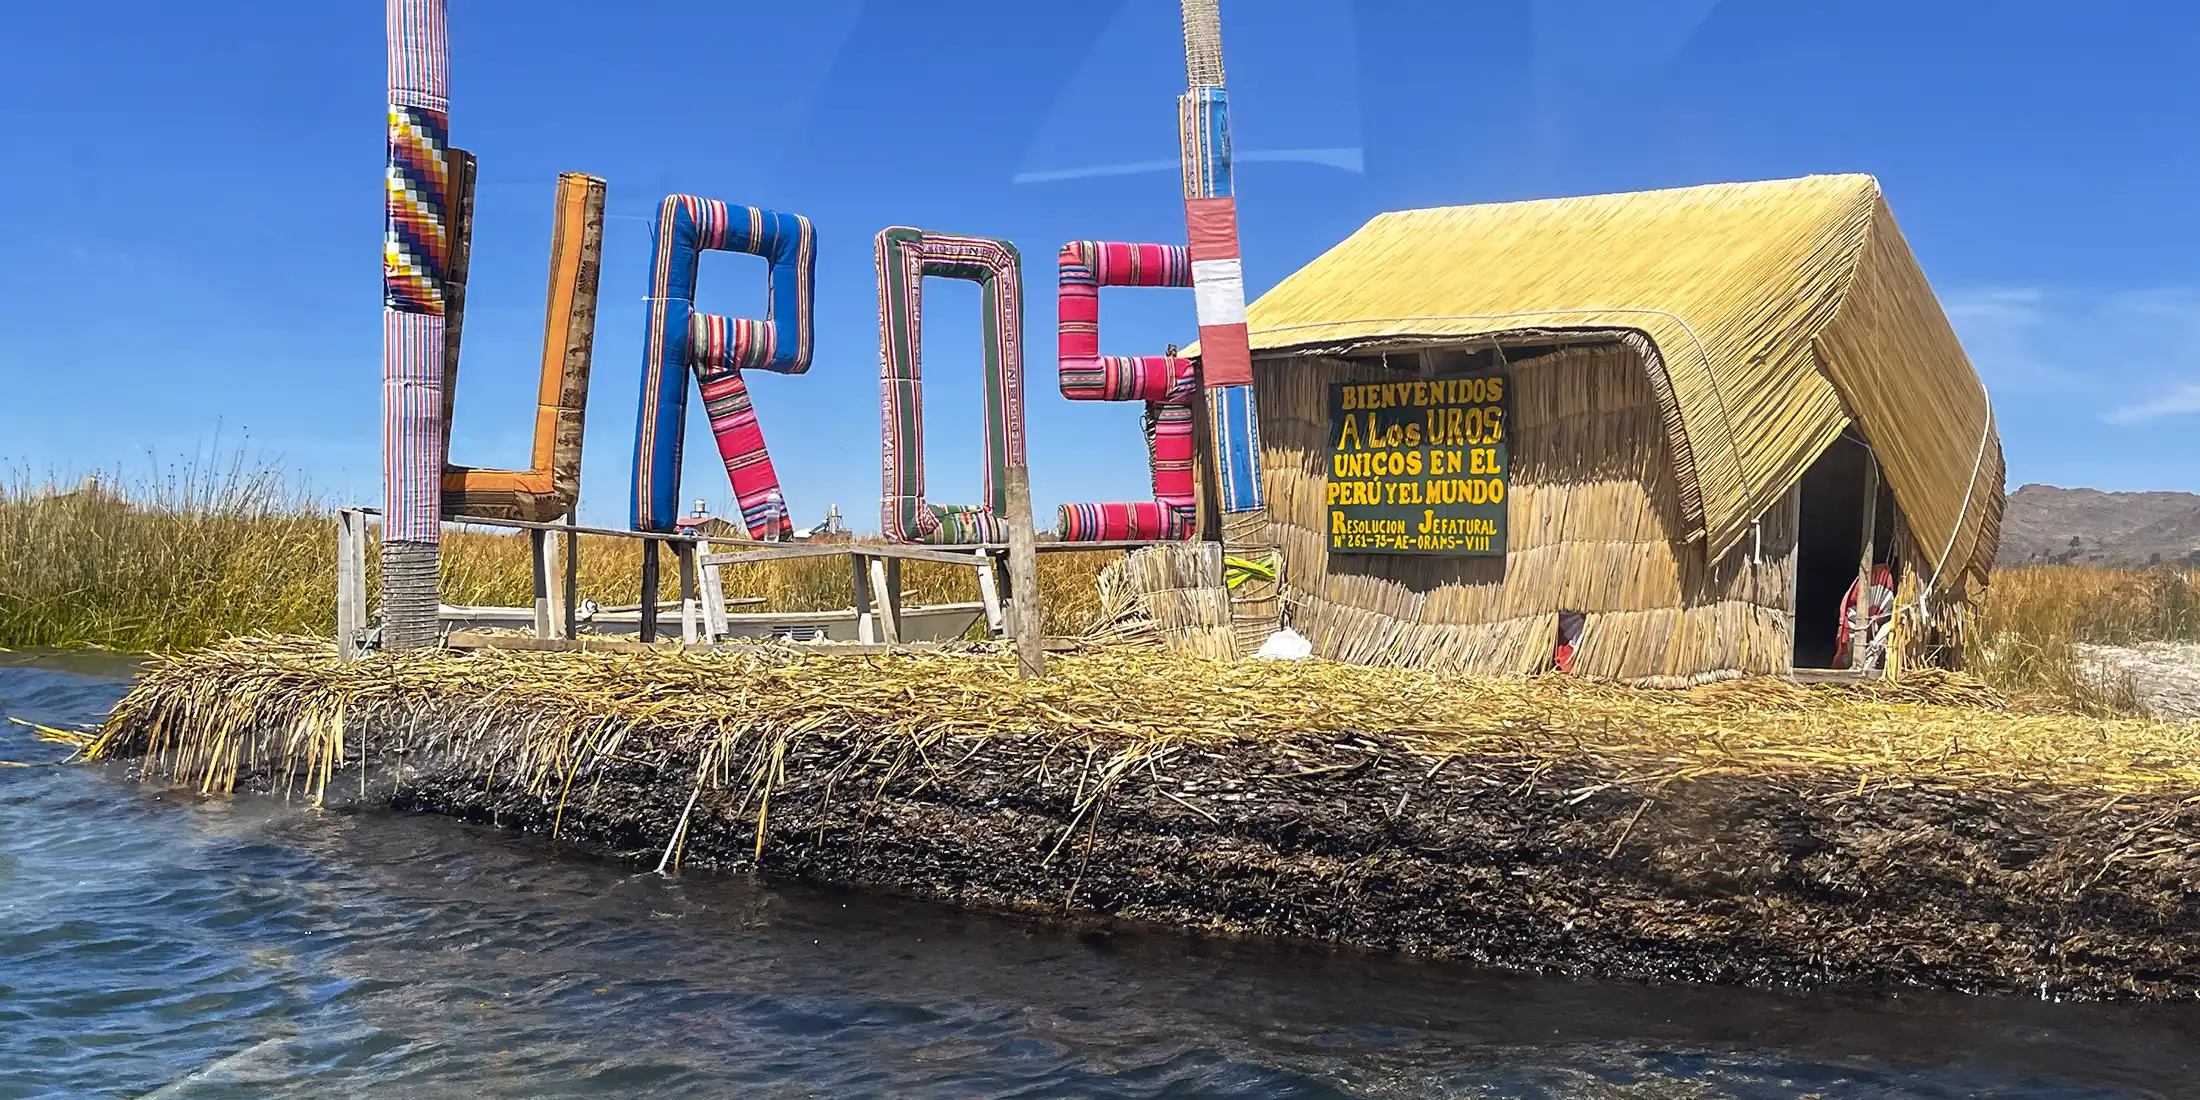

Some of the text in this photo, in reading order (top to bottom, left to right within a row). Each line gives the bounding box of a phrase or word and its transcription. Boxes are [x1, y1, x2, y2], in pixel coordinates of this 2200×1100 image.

[440, 147, 1197, 544] UROS
[1341, 378, 1503, 410] BIENVENIDOS
[1337, 413, 1361, 450] A
[1426, 406, 1503, 446] UROS
[1333, 448, 1501, 478] UNICOS EN EL
[1327, 476, 1381, 505] PERÚ
[1426, 478, 1504, 505] MUNDO
